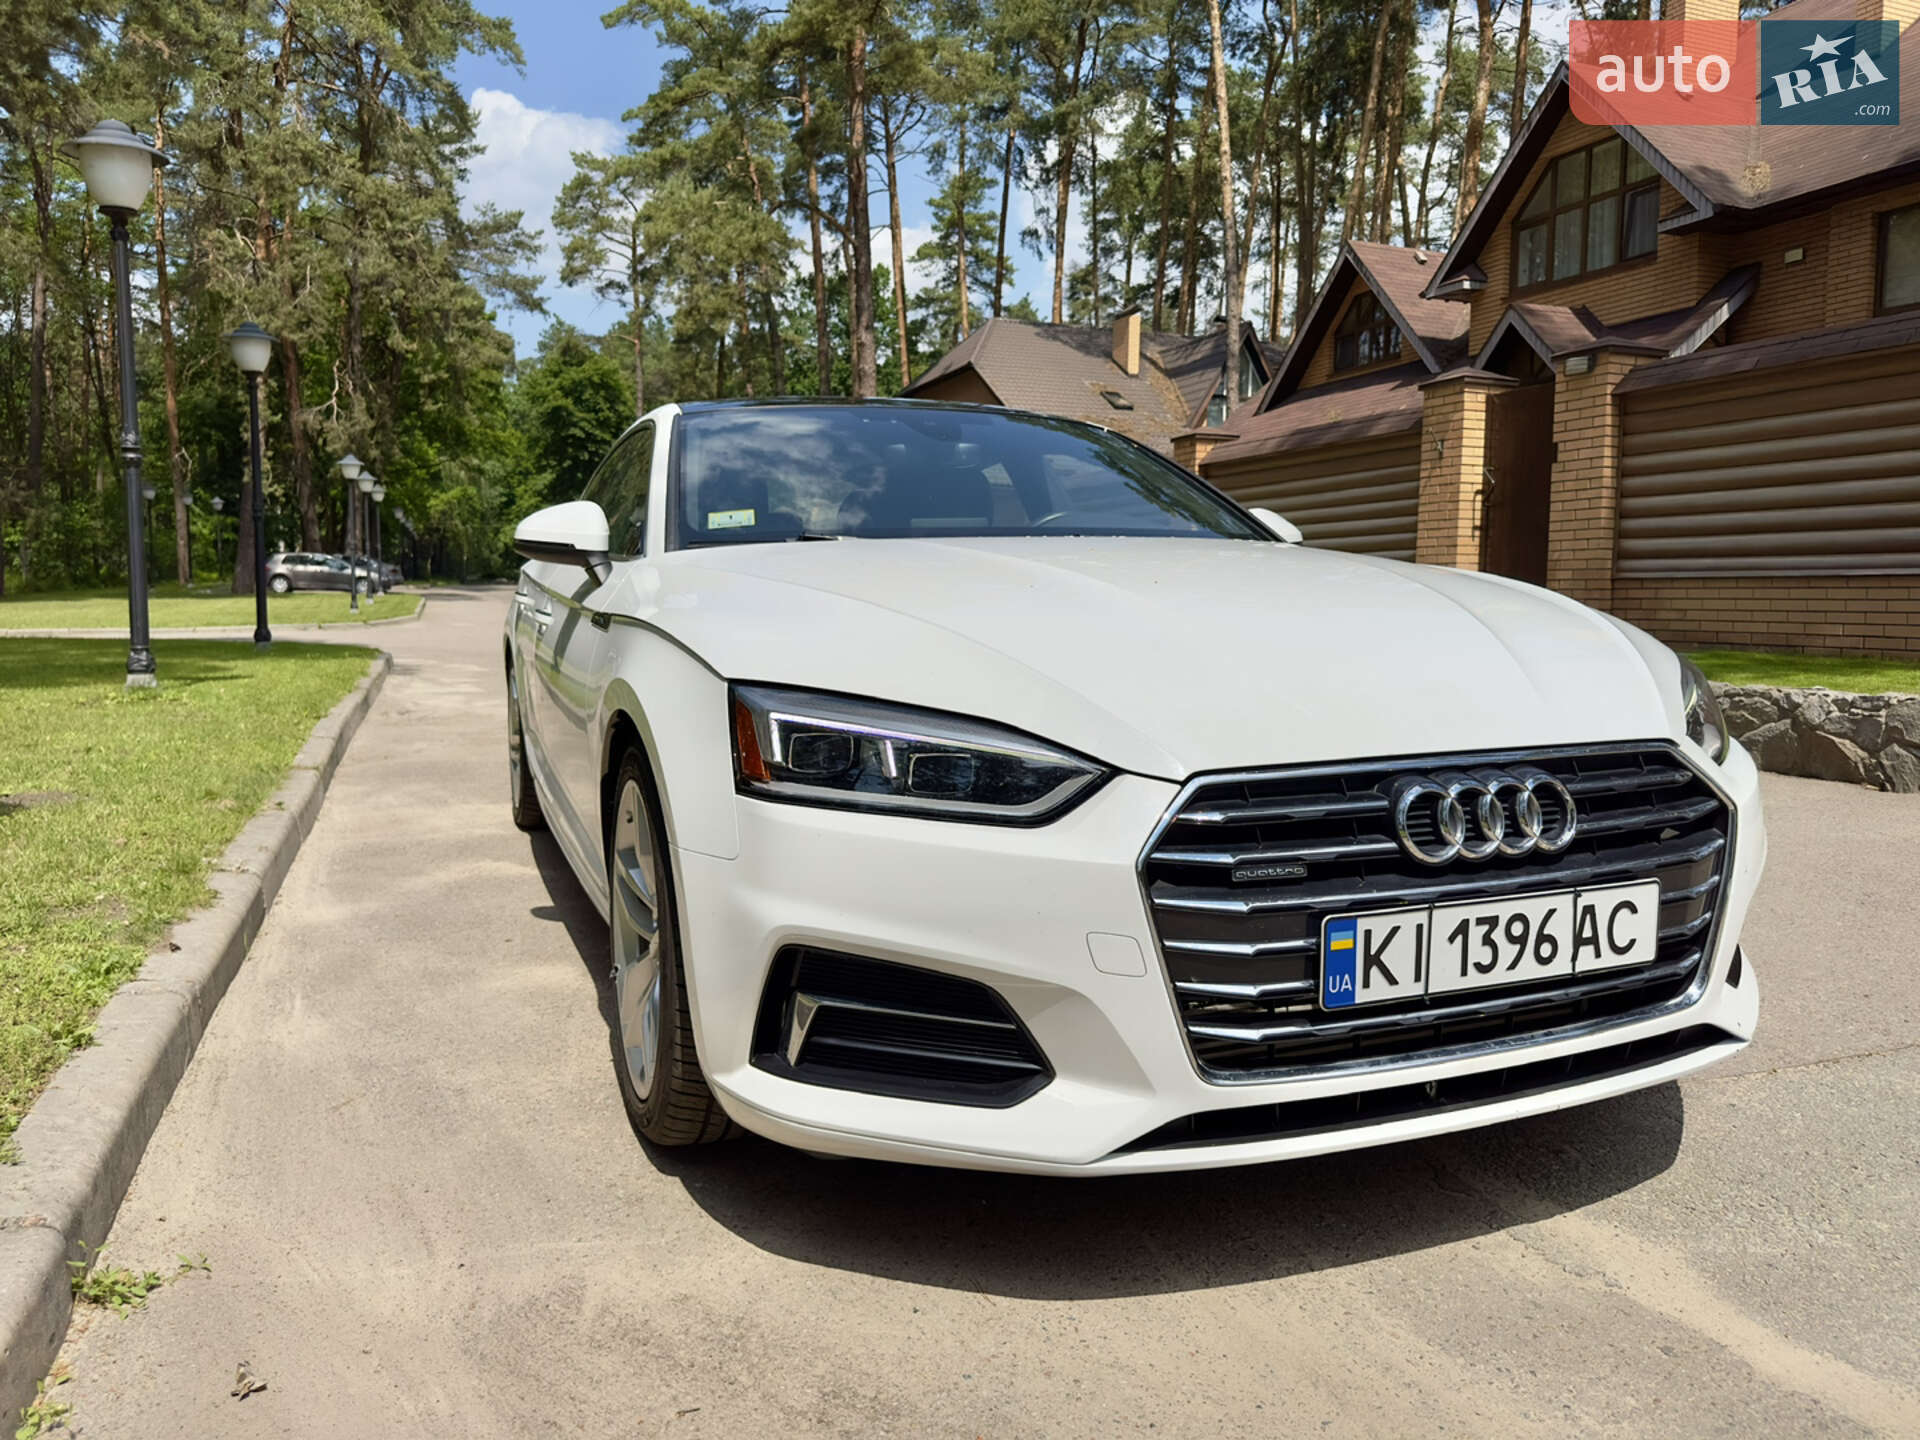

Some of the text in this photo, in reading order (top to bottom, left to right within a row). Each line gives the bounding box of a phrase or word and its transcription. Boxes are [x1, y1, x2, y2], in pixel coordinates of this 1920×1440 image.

[1235, 866, 1305, 880] quattro
[1362, 900, 1638, 989] KI 1396 AC
[1328, 975, 1353, 994] UA
